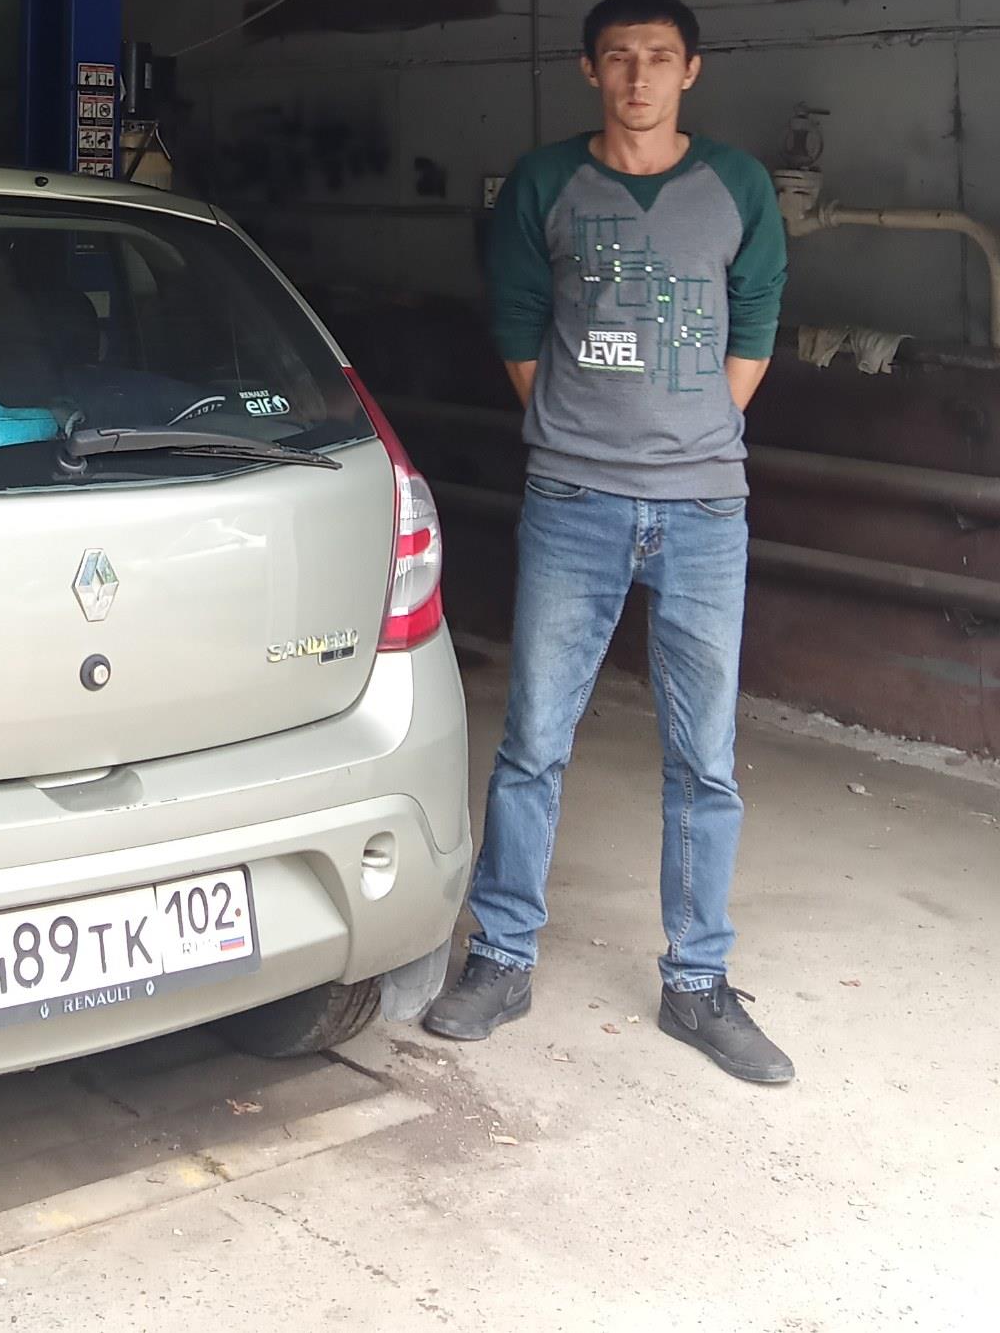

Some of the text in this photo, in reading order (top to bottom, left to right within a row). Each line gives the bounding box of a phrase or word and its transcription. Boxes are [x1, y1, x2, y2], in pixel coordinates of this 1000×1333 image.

[588, 331, 637, 342] STREETS
[578, 341, 645, 366] LEVEL
[164, 882, 235, 938] 102
[63, 986, 132, 1013] RENAULT
